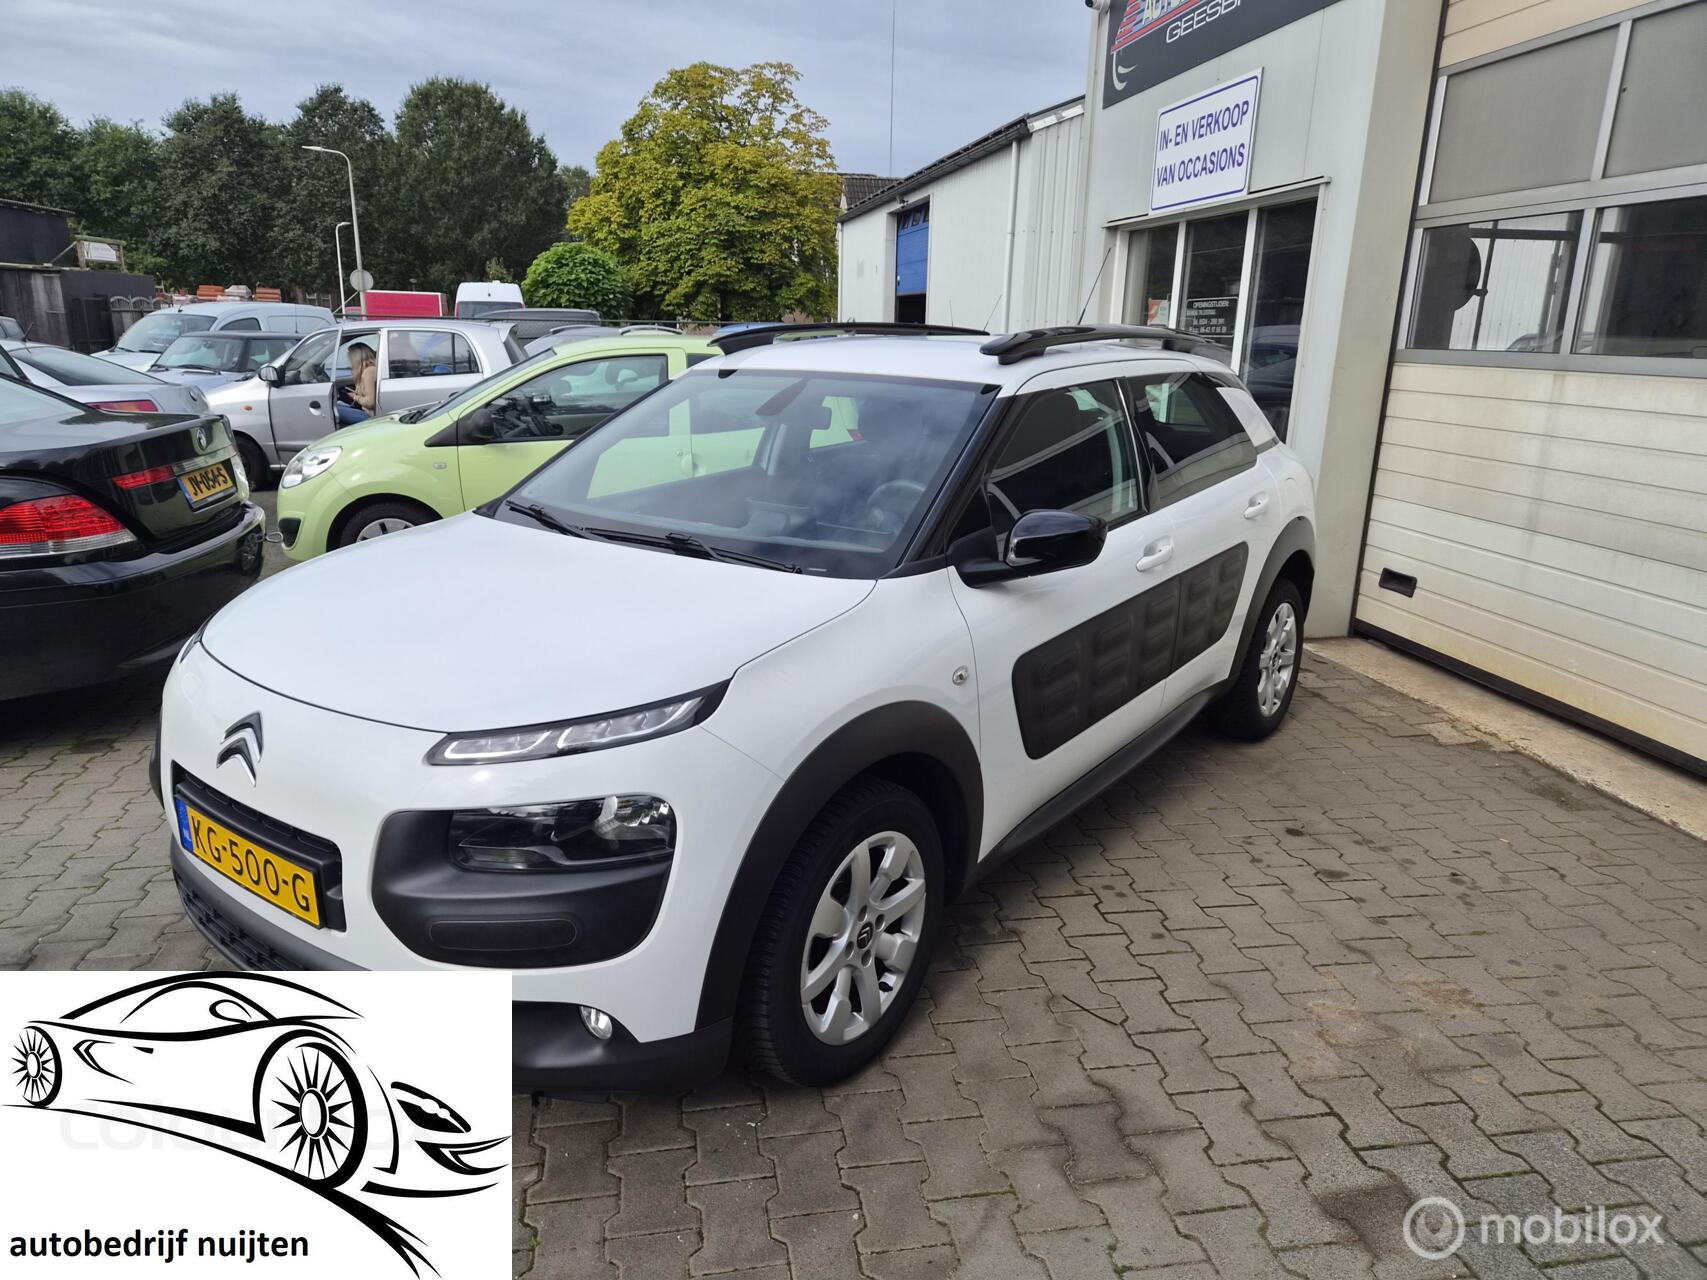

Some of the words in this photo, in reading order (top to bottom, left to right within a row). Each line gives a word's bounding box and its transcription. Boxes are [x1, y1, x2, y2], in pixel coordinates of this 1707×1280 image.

[1166, 0, 1240, 43] GEESB
[1159, 128, 1173, 151] IN-
[1174, 121, 1189, 147] EN
[1192, 99, 1250, 141] VERKOOP
[1157, 162, 1176, 188] VAN
[1177, 142, 1246, 183] OCCASIONS
[191, 815, 311, 913] KG-500-G
